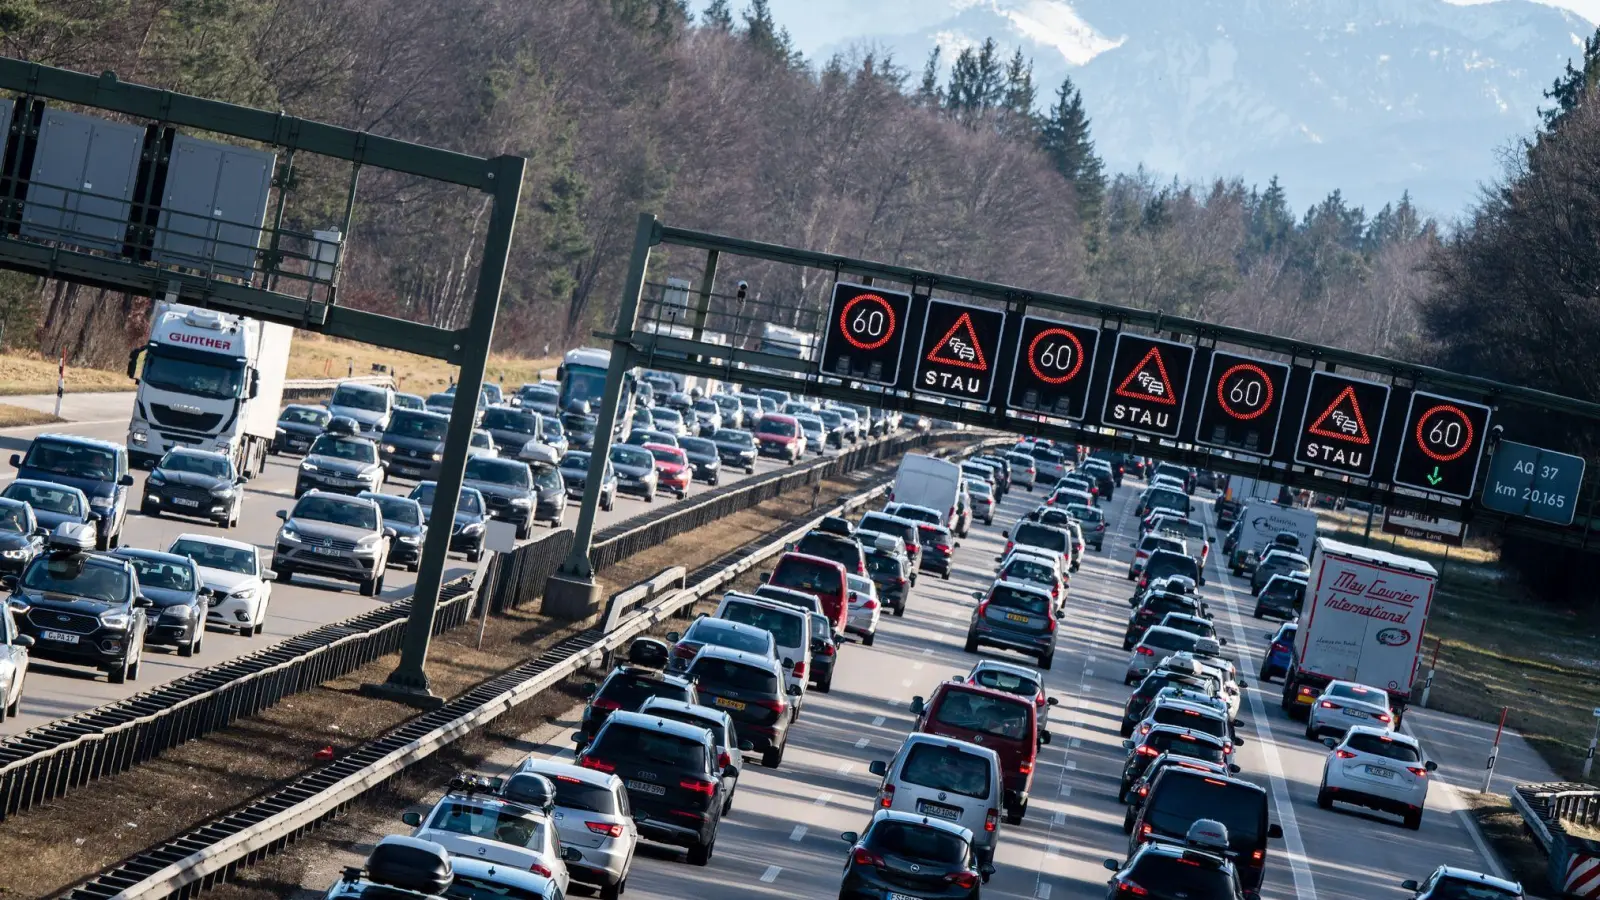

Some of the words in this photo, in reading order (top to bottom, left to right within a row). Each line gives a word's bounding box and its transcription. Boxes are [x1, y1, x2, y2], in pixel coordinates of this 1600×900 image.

[853, 309, 884, 336] 60
[169, 332, 232, 350] GUNTHER
[1040, 342, 1072, 370] 60
[924, 370, 981, 393] STAU
[1230, 378, 1261, 407] 60
[1113, 404, 1169, 428] STAU
[1429, 419, 1461, 448] 60
[1306, 442, 1362, 467] STAU
[1513, 460, 1535, 475] AQ
[1541, 465, 1559, 480] 37
[1495, 481, 1517, 497] km
[1522, 487, 1566, 508] 20.165
[1329, 571, 1367, 596] May
[1366, 580, 1420, 603] Courier
[1324, 592, 1411, 625] International
